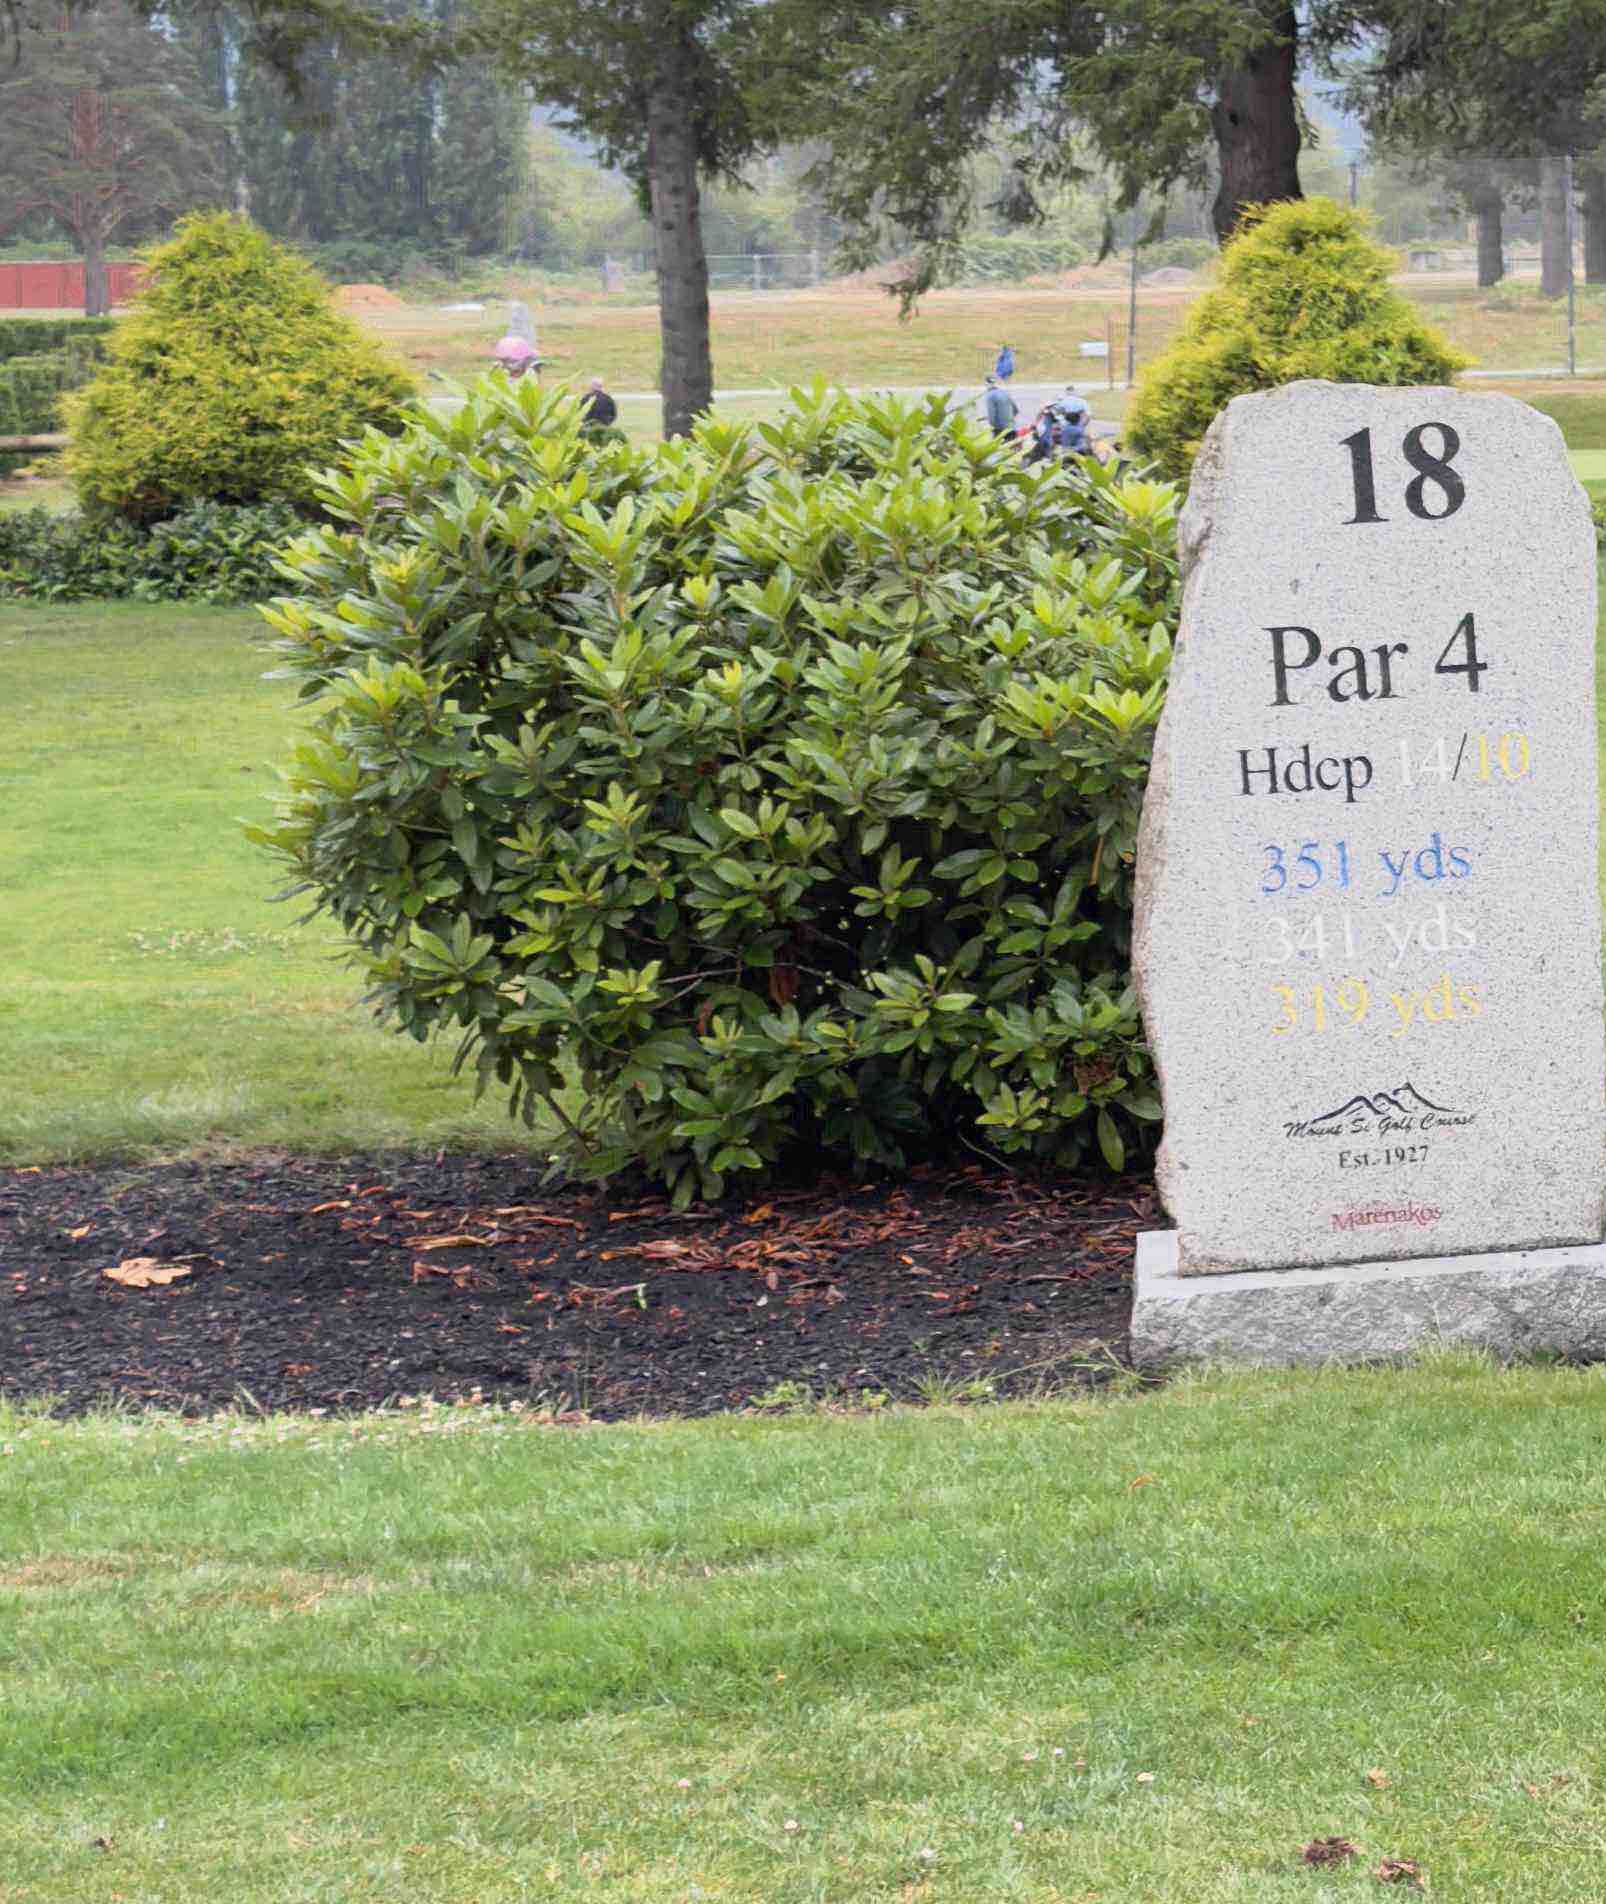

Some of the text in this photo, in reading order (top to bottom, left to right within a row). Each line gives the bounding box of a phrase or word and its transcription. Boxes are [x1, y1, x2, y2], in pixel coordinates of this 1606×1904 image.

[1338, 422, 1465, 524] 18
[1262, 612, 1487, 707] Par 4
[1236, 744, 1373, 803] Hdcp
[1262, 832, 1471, 895] 351 yds
[1264, 902, 1477, 968] 341 yds
[1269, 969, 1486, 1038] 319 yds
[1283, 1110, 1476, 1138] Mount Si Golf Course
[1339, 1145, 1429, 1169] Est. 1927
[1331, 1199, 1442, 1231] Marenakos
